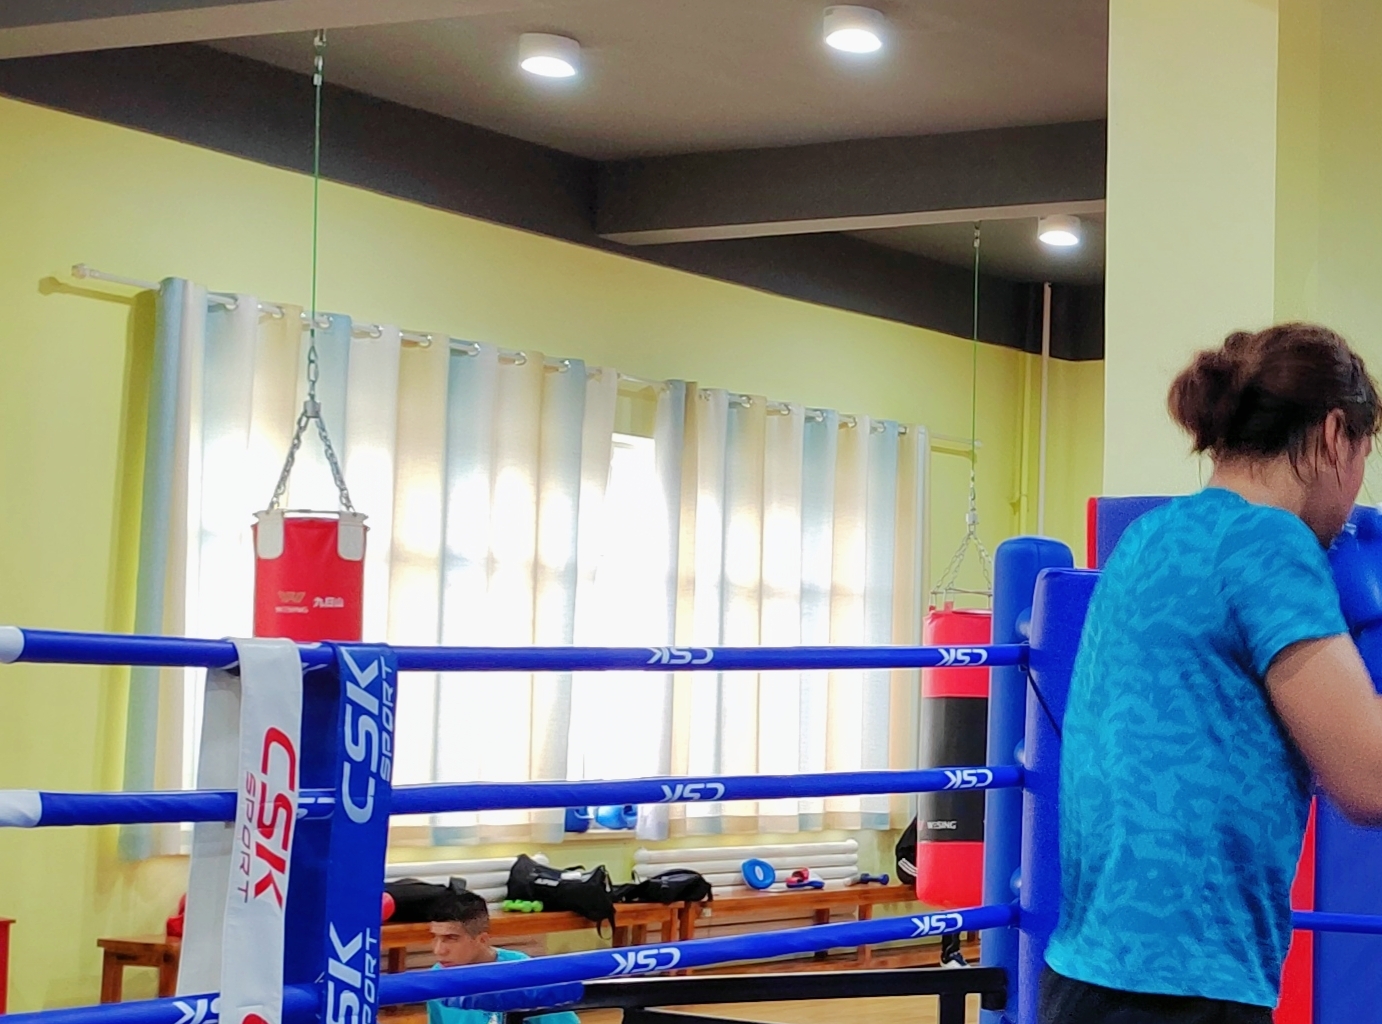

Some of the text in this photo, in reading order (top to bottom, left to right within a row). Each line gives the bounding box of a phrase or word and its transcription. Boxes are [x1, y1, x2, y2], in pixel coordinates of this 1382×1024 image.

[646, 646, 714, 665] CSK
[935, 648, 988, 666] CSK
[379, 655, 395, 783] SPORT
[341, 646, 380, 824] CSK
[943, 769, 993, 789] CSK
[660, 783, 726, 802] CSK
[254, 726, 297, 910] CSK
[237, 771, 257, 903] SPORT
[910, 913, 963, 937] CSK
[609, 947, 681, 975] CSK
